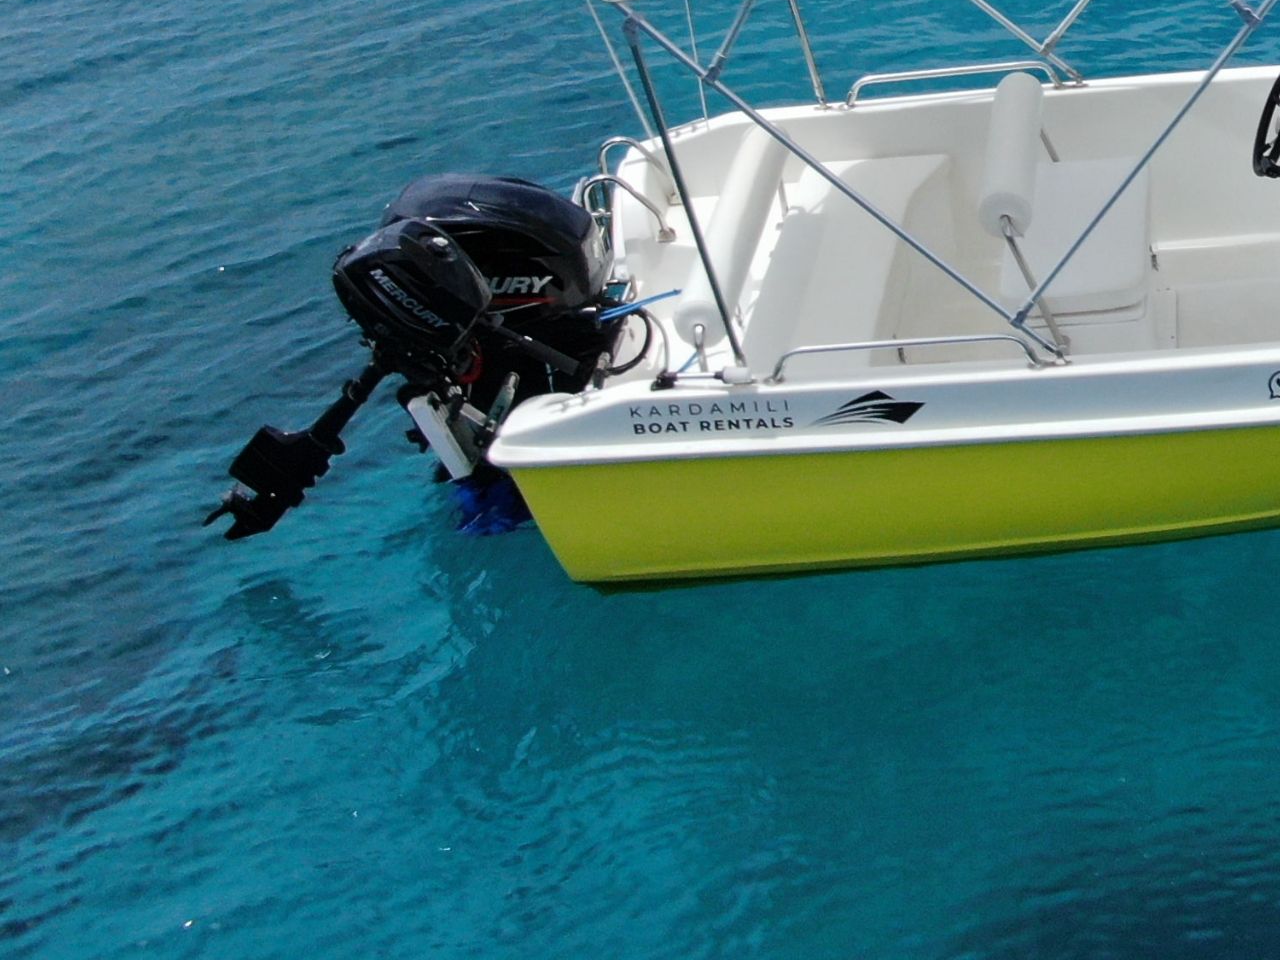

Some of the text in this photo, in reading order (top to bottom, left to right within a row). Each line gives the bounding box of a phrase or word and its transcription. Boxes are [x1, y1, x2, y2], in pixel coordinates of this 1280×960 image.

[487, 275, 554, 295] URY
[368, 268, 451, 328] MERCURY
[629, 399, 790, 419] KARDAMILI
[633, 416, 795, 435] BOAT RENTALS
